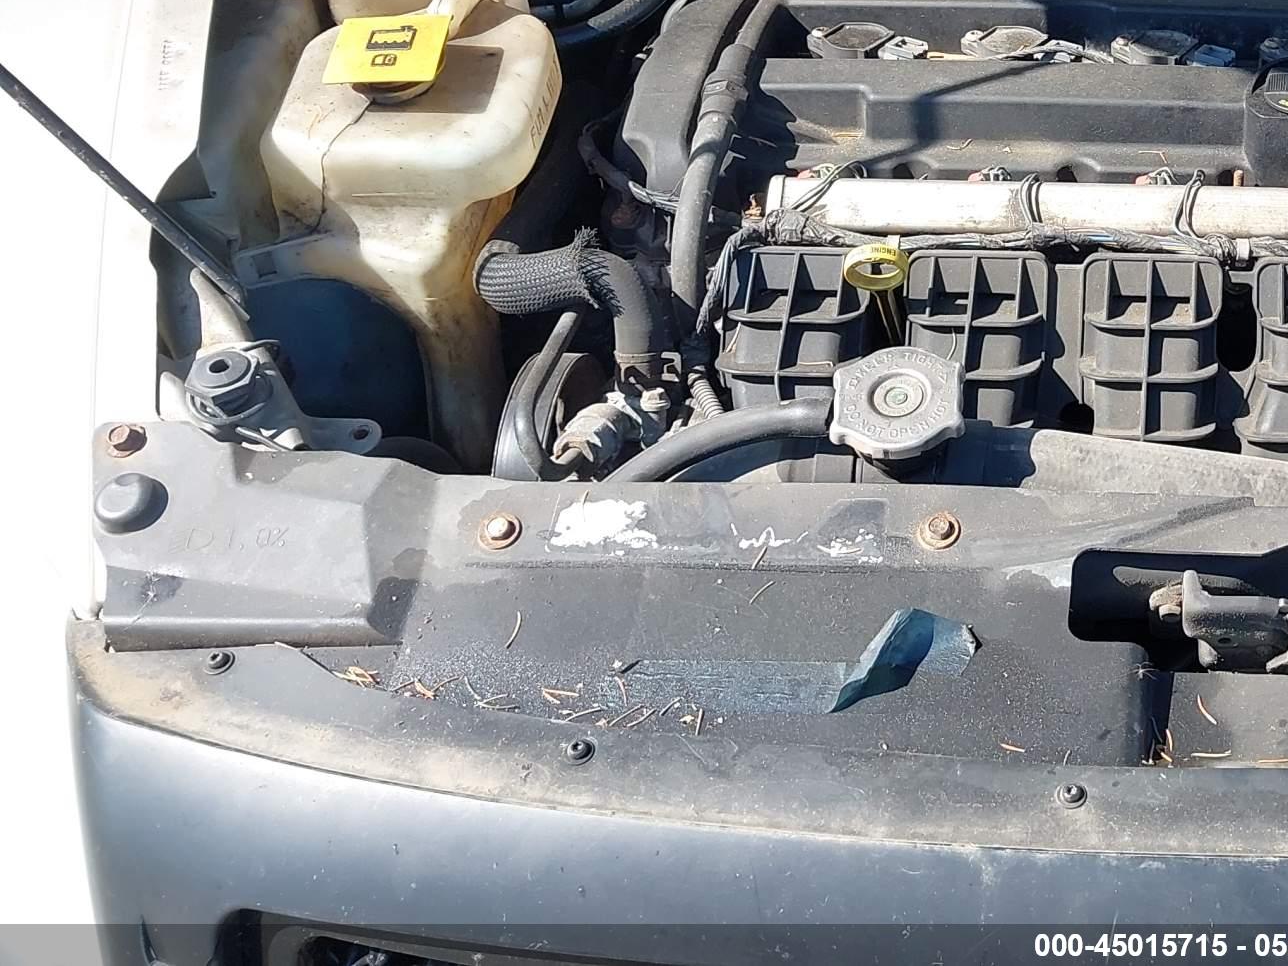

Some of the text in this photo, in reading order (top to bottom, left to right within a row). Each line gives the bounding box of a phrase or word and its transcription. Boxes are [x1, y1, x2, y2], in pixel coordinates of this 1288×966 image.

[903, 352, 944, 371] TIGHT
[845, 399, 949, 438] DO NOT OPEN HOT
